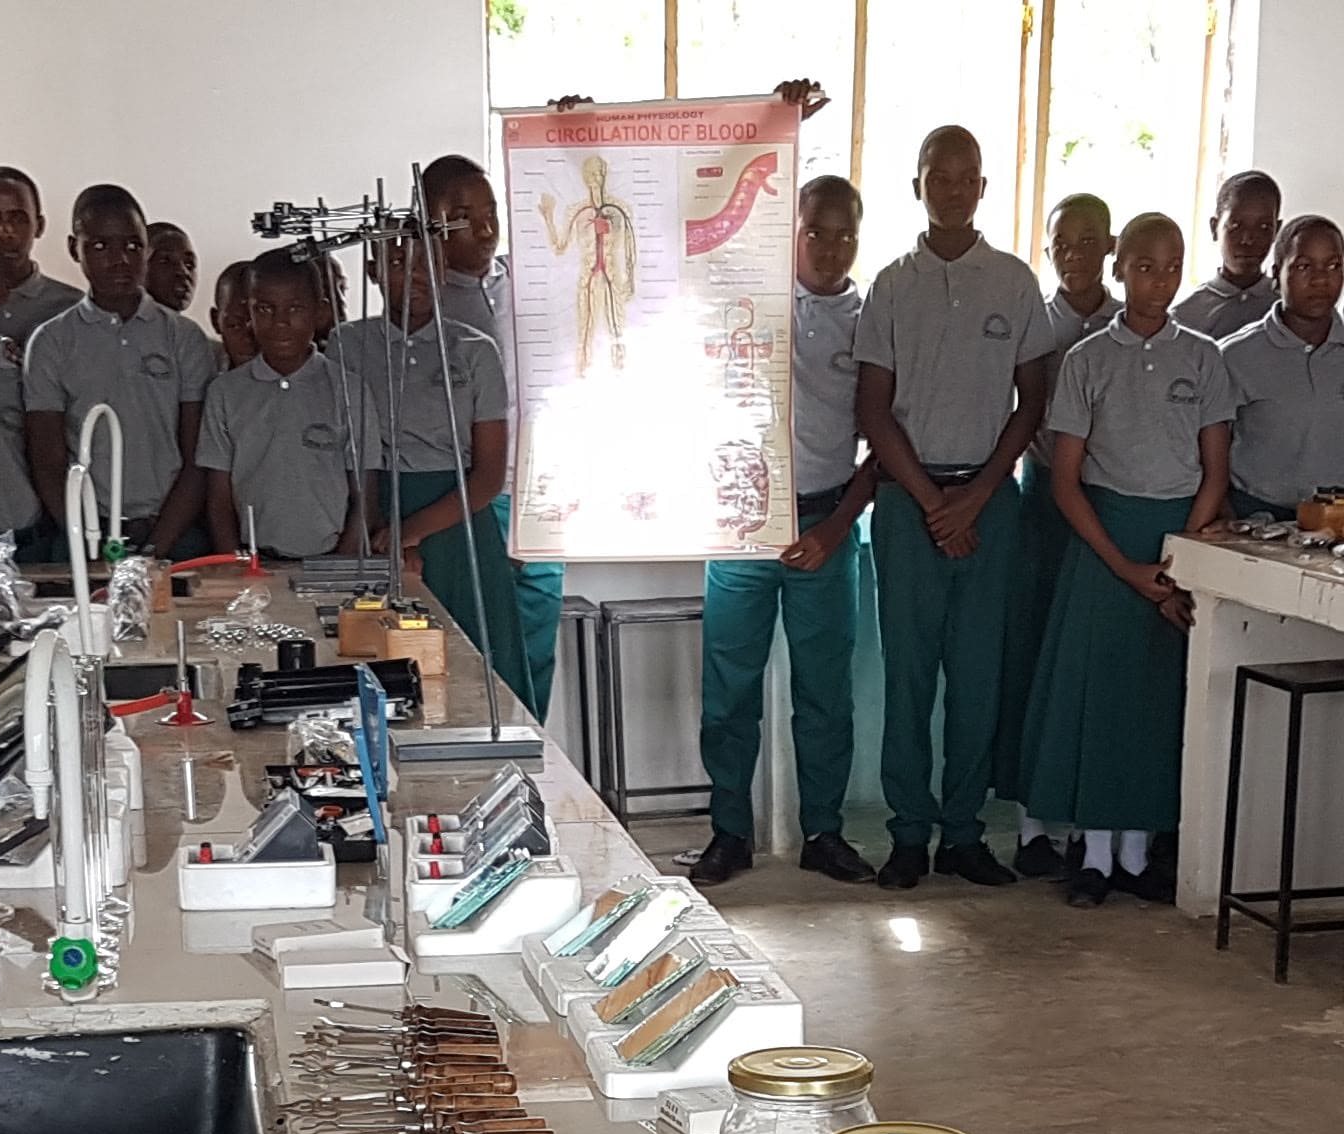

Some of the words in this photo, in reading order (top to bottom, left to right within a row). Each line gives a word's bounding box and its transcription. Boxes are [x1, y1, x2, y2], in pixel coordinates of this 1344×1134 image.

[545, 126, 663, 143] CIRCULATION
[668, 125, 690, 140] OF
[697, 123, 757, 140] BLOOD
